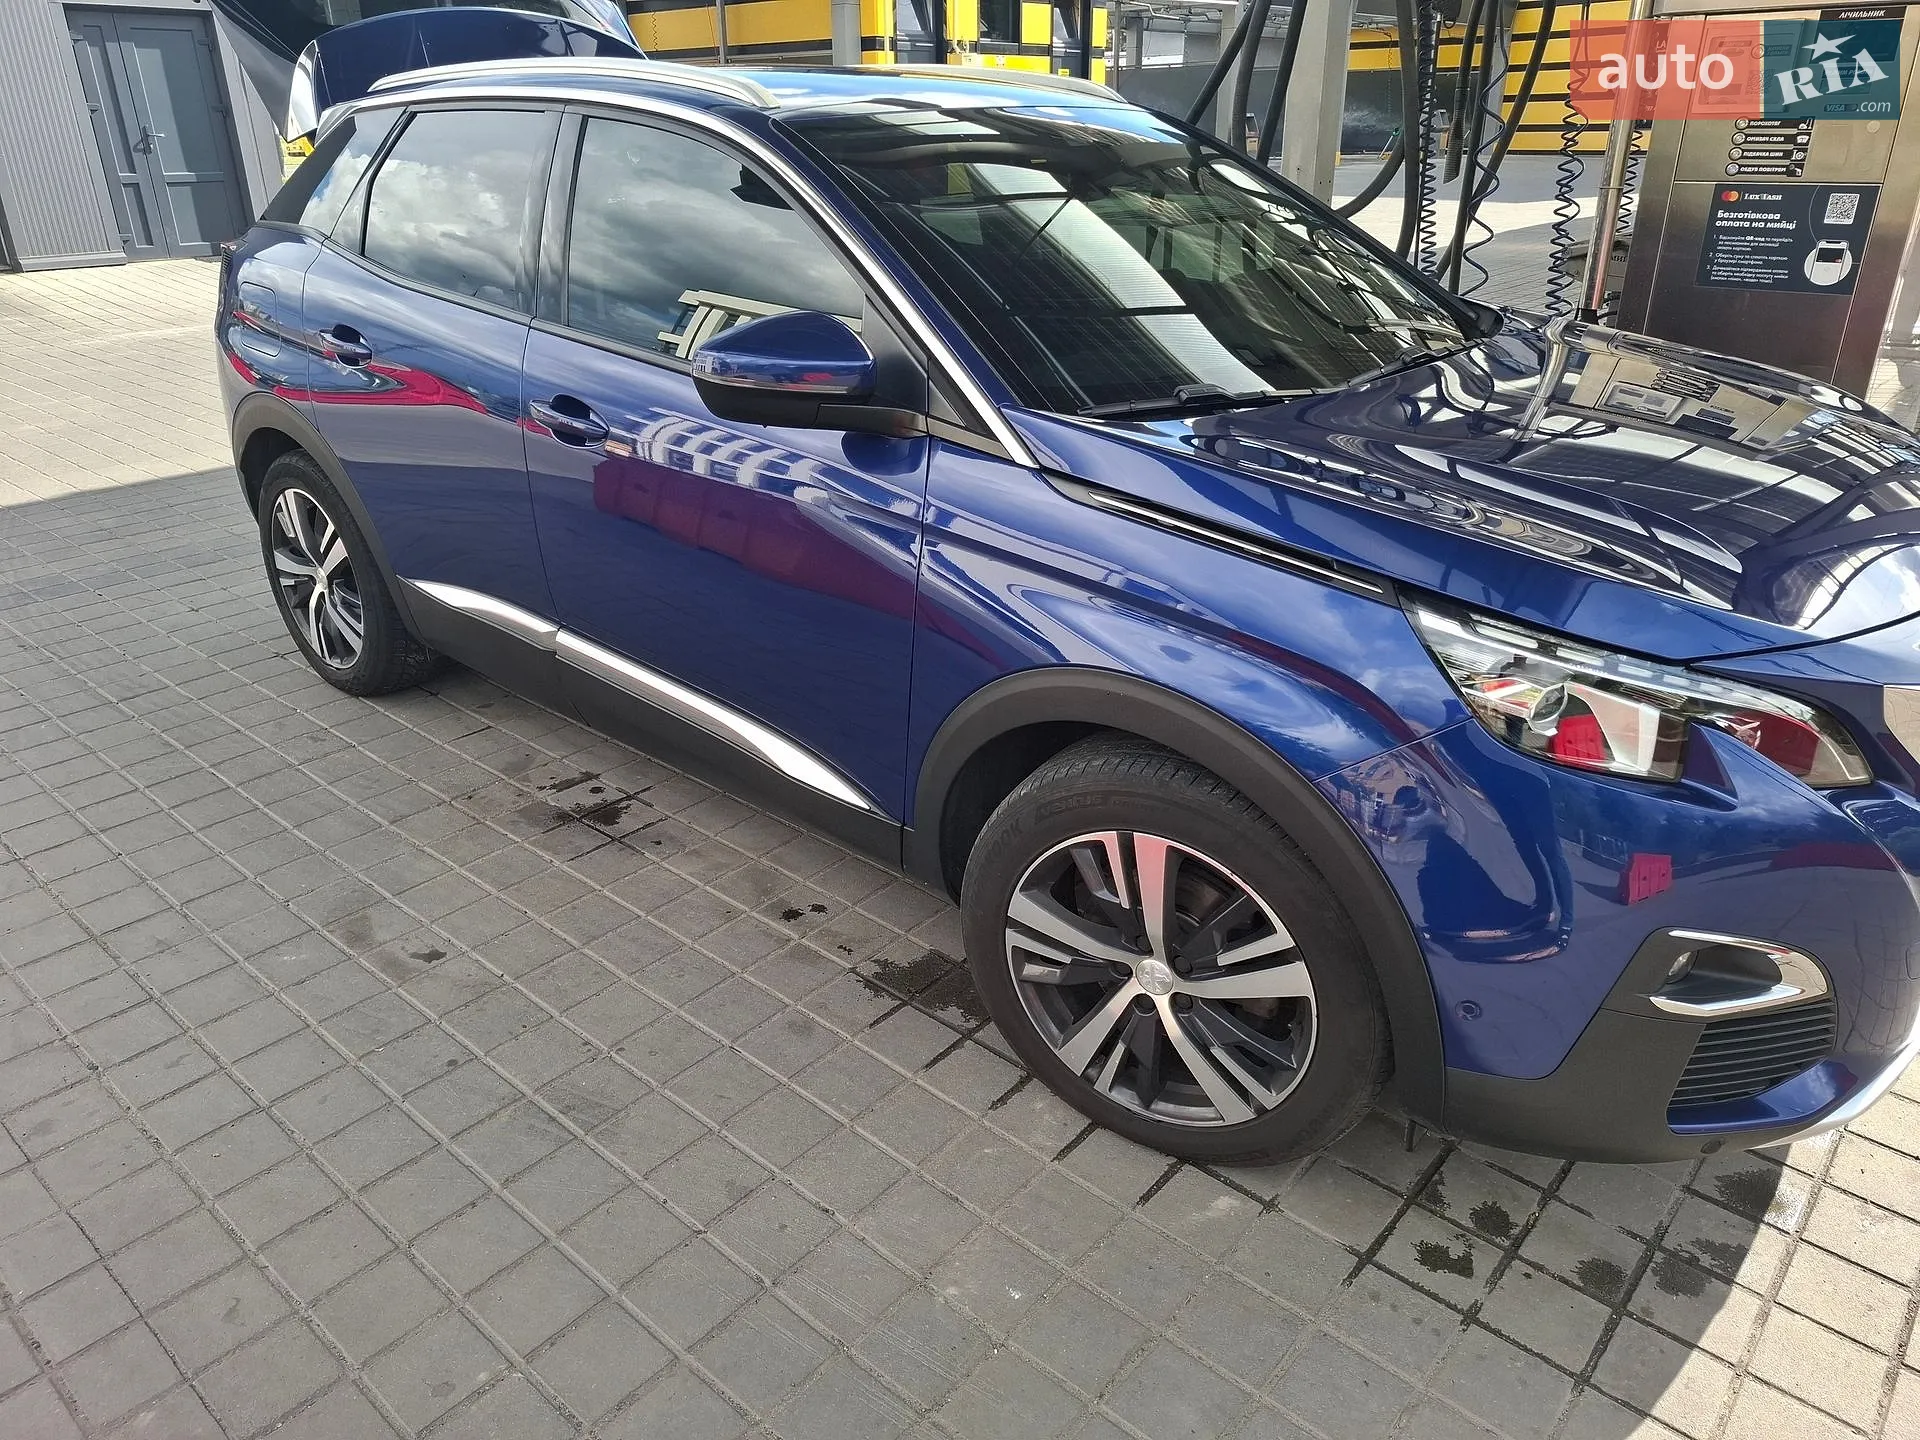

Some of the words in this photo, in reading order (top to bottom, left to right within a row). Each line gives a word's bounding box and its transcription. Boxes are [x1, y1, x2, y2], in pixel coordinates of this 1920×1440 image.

[1839, 10, 1886, 19] ЛІЧИЛЬНИК
[1717, 210, 1781, 220] Безготівкова
[1715, 220, 1750, 228] оплата
[1766, 220, 1796, 230] мийці
